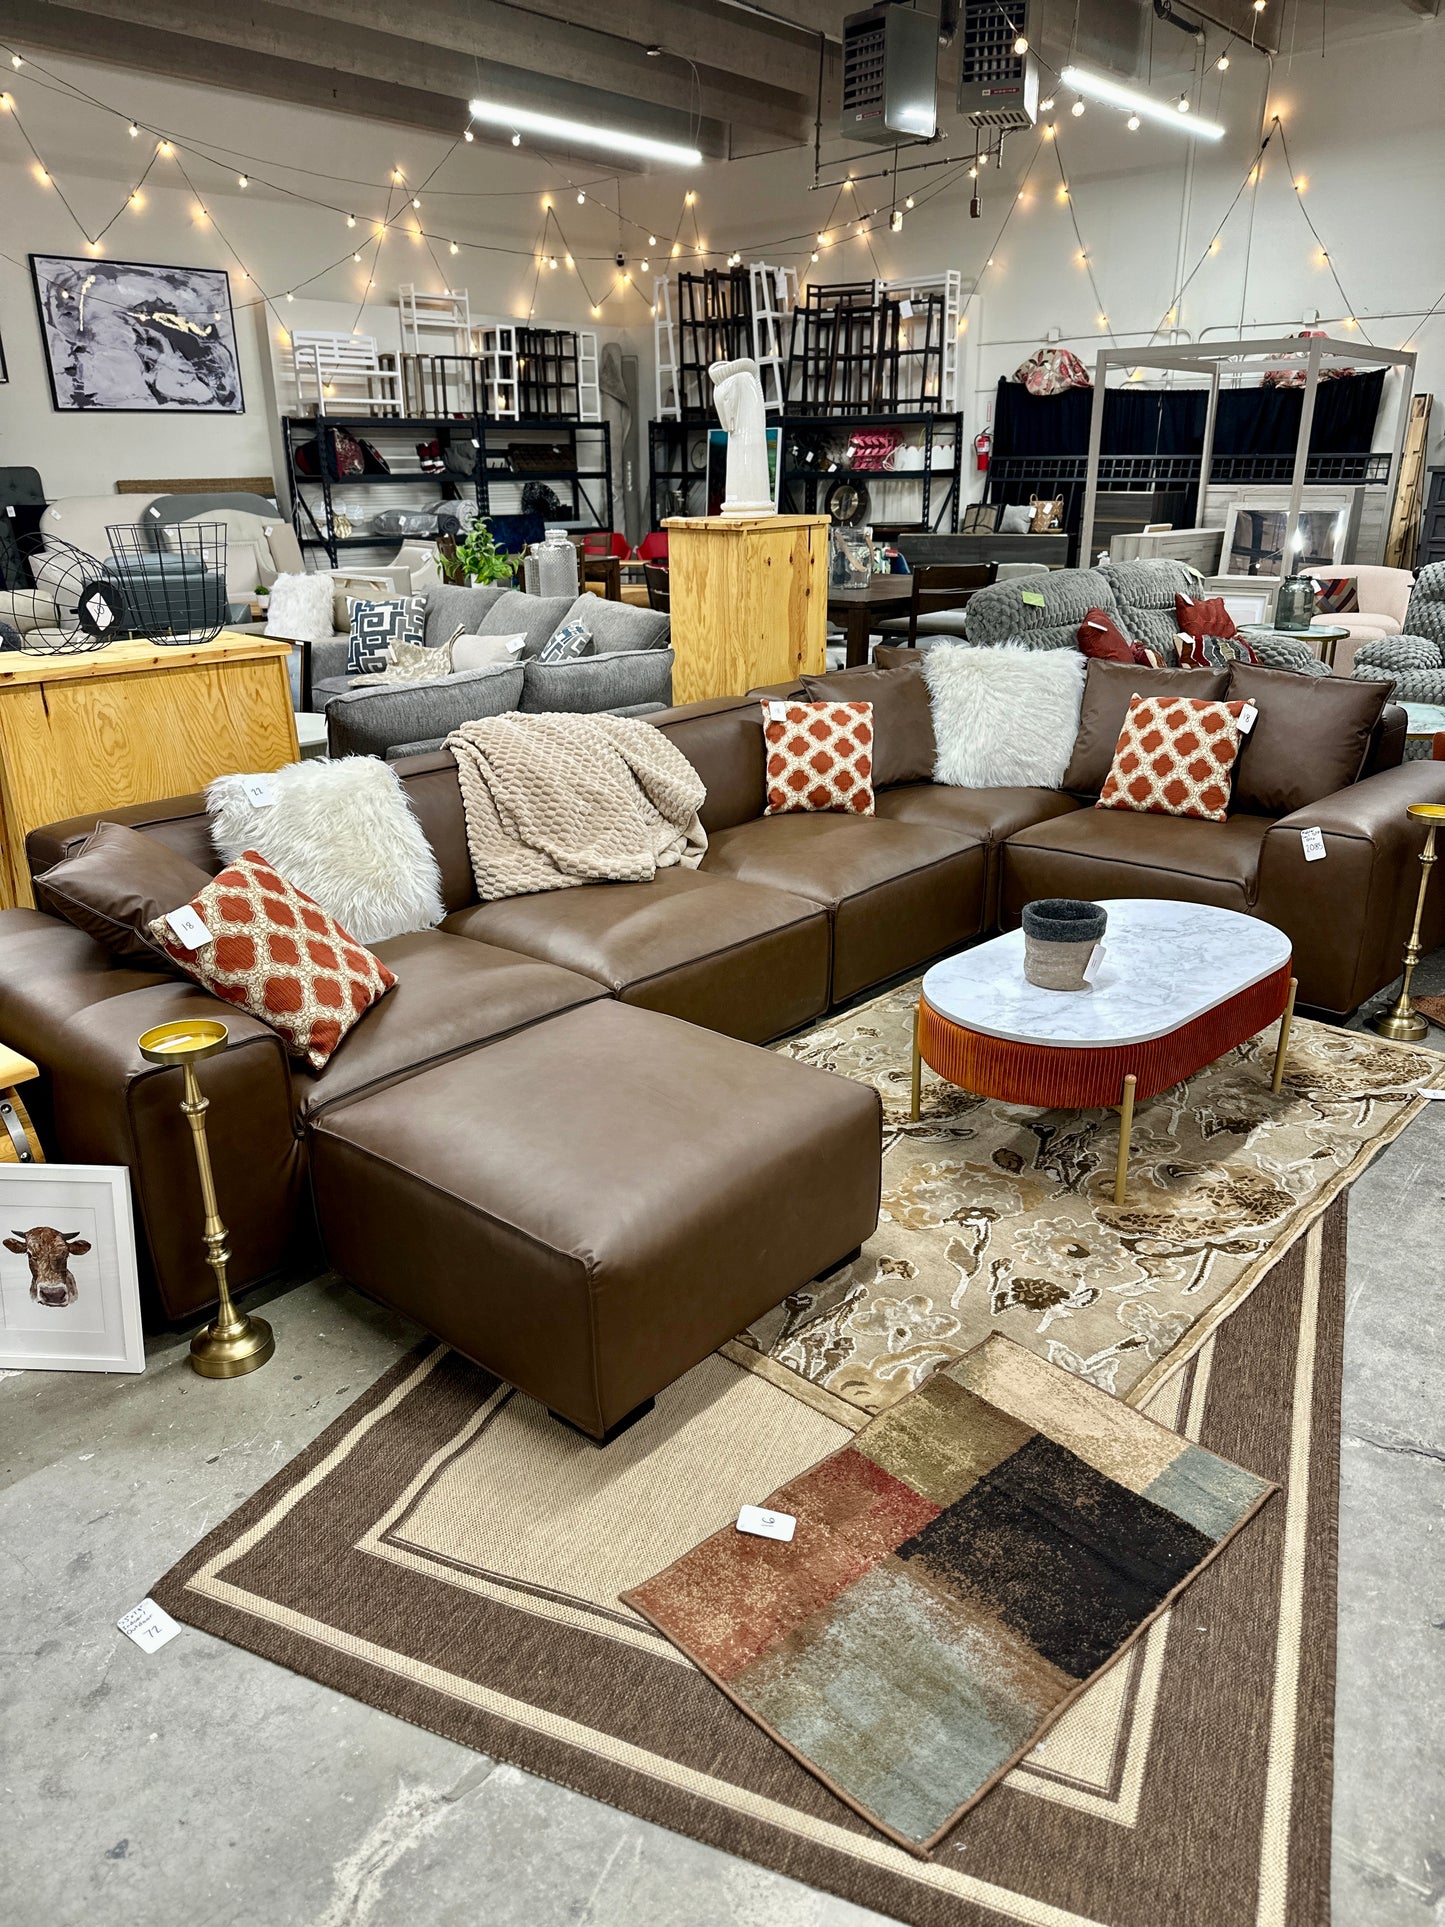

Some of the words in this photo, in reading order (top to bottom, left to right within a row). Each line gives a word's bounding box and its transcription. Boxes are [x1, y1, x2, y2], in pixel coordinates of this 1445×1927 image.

[251, 787, 264, 796] 22
[181, 921, 195, 932] 18
[142, 1625, 163, 1638] 72
